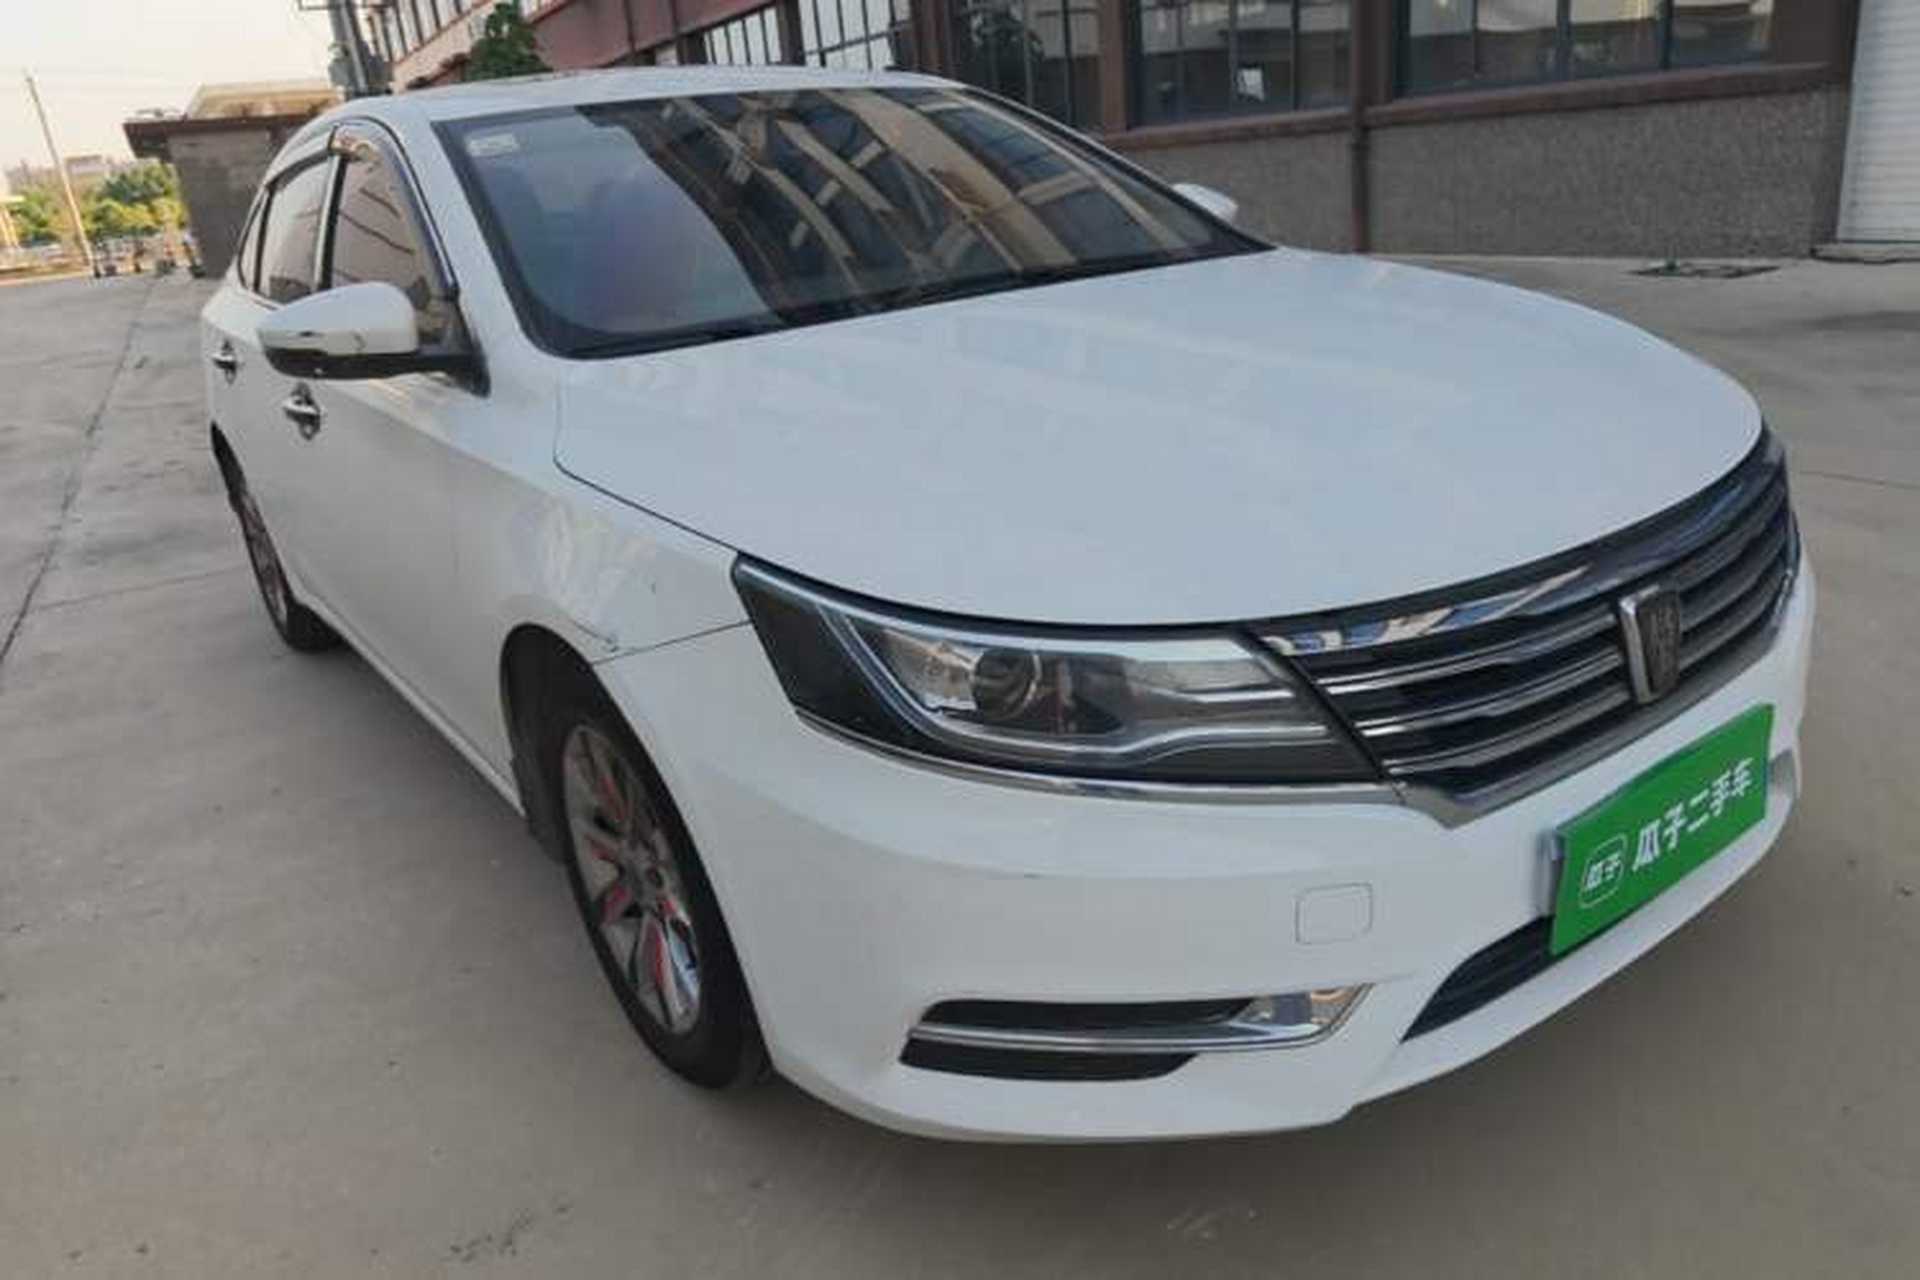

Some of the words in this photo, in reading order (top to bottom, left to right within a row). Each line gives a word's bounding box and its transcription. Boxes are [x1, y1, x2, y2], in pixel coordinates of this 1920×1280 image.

[1632, 757, 1754, 872] 瓜子二手车
